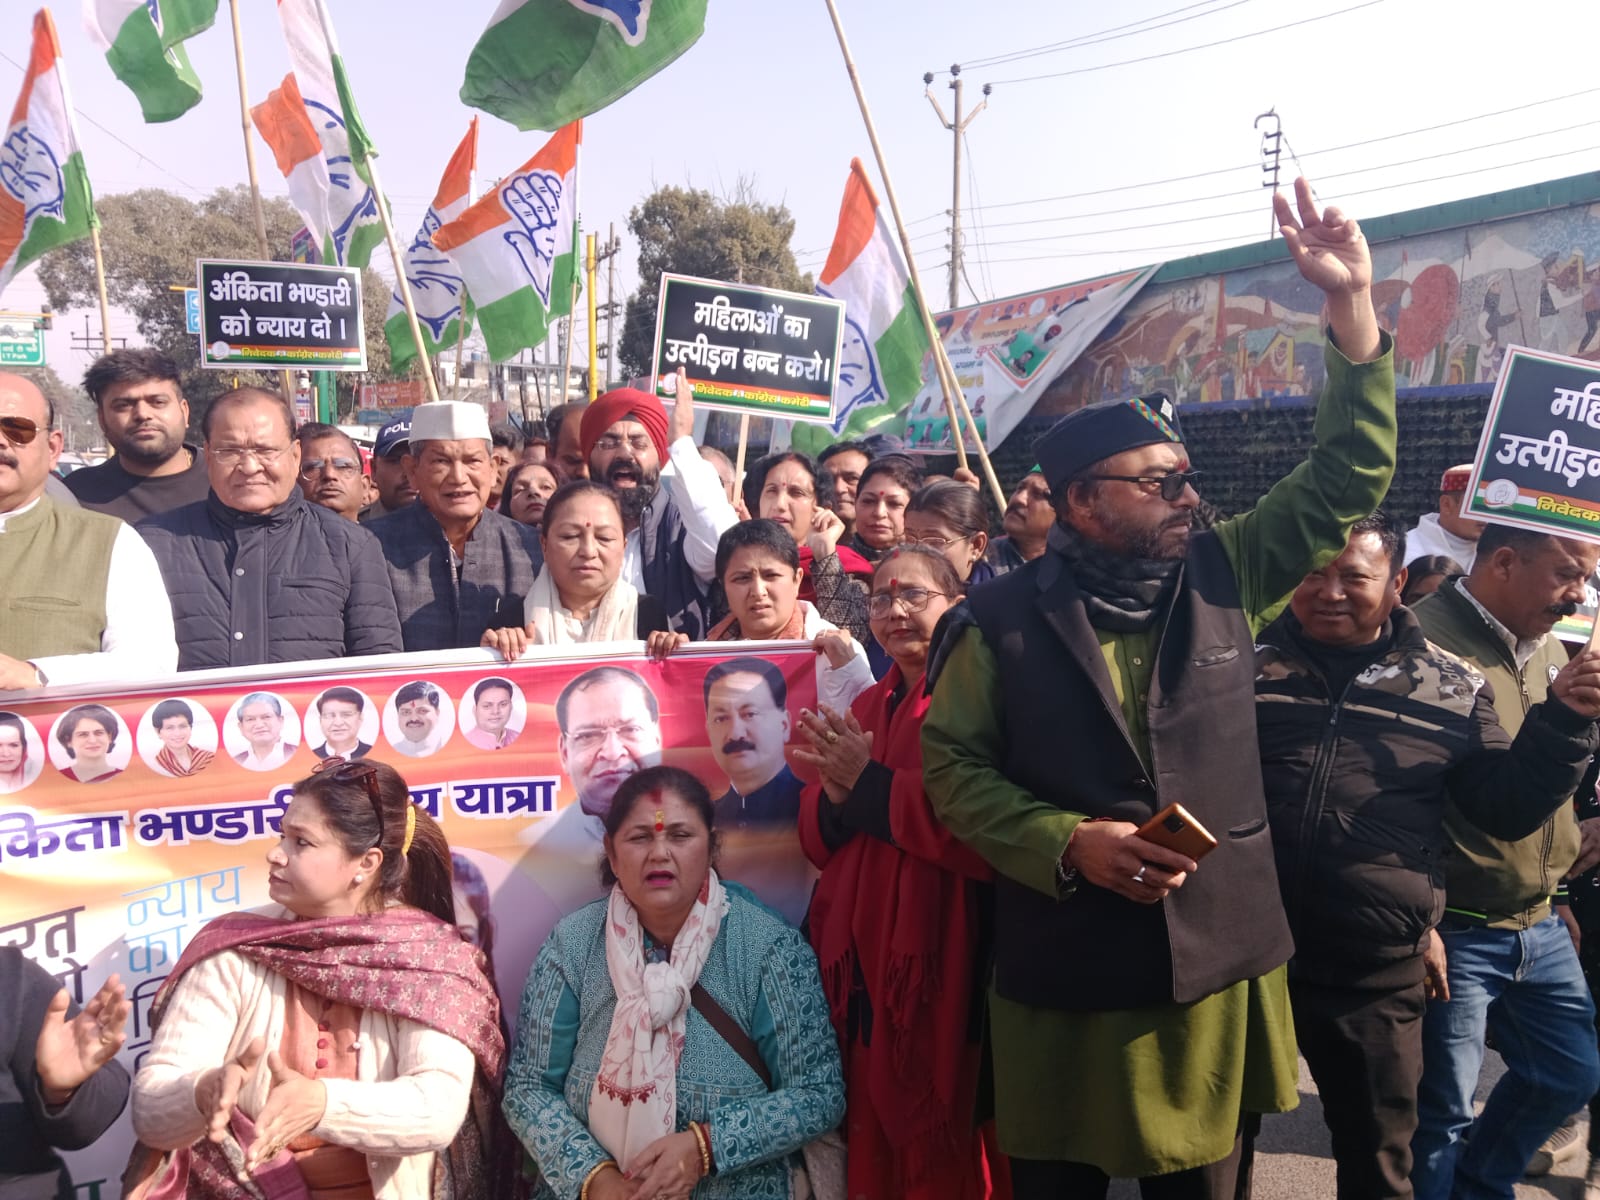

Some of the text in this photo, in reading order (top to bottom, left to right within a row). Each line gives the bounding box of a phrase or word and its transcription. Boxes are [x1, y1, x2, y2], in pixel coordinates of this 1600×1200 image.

[209, 271, 351, 307] अंकिता भण्डारी
[220, 308, 251, 337] को
[255, 316, 306, 339] न्याय
[694, 295, 811, 340] महिलाओं का
[665, 333, 740, 375] उत्पीड़न
[743, 348, 782, 375] बन्द
[694, 383, 733, 399] निवेदक
[744, 388, 778, 404] कांग्रेस
[1550, 381, 1600, 430] महि
[383, 421, 412, 437] POLI
[0, 812, 123, 863] किता
[453, 780, 556, 815] यात्रा
[122, 866, 246, 926] न्याय
